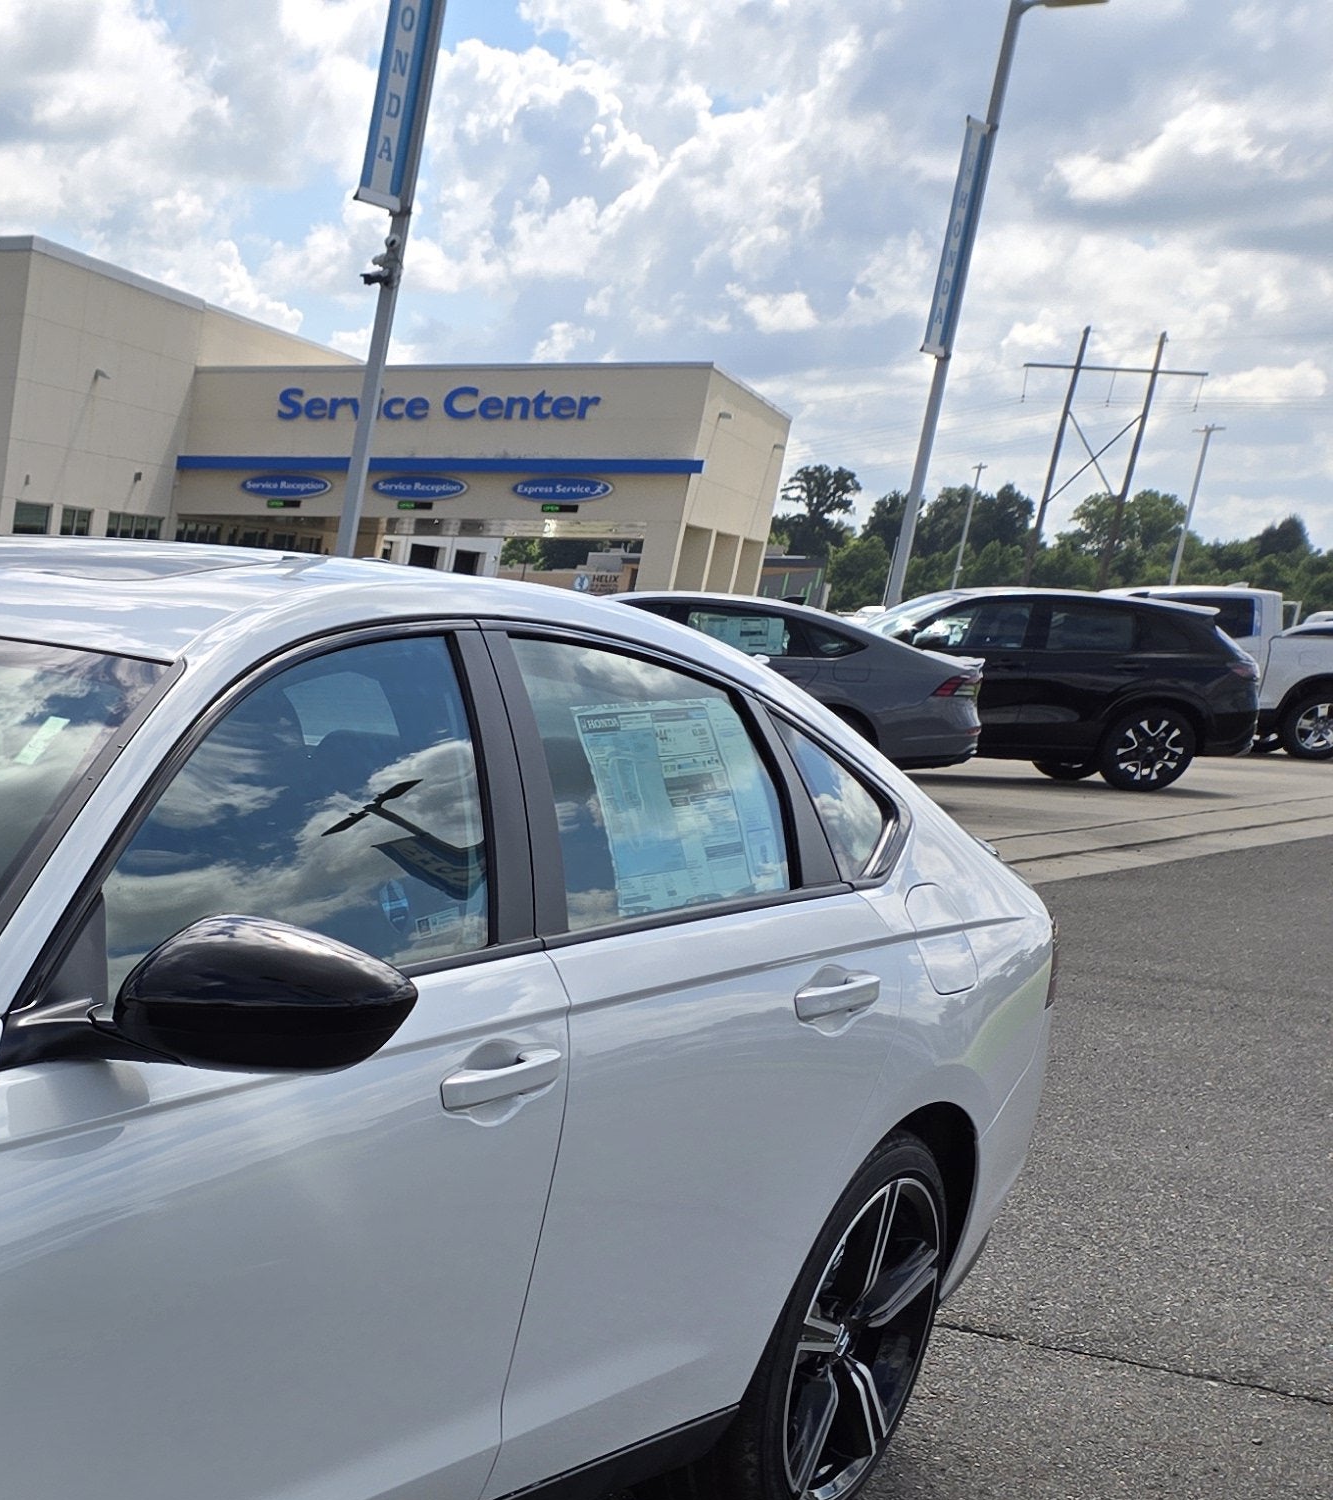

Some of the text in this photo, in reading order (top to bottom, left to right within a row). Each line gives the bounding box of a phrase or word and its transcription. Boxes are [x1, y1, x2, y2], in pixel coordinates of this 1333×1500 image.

[443, 385, 603, 421] Center
[245, 480, 325, 491] Service Reception
[378, 481, 461, 493] Service Reception
[516, 484, 591, 495] Express Service
[592, 574, 620, 583] HELIX
[587, 717, 620, 729] HONDA
